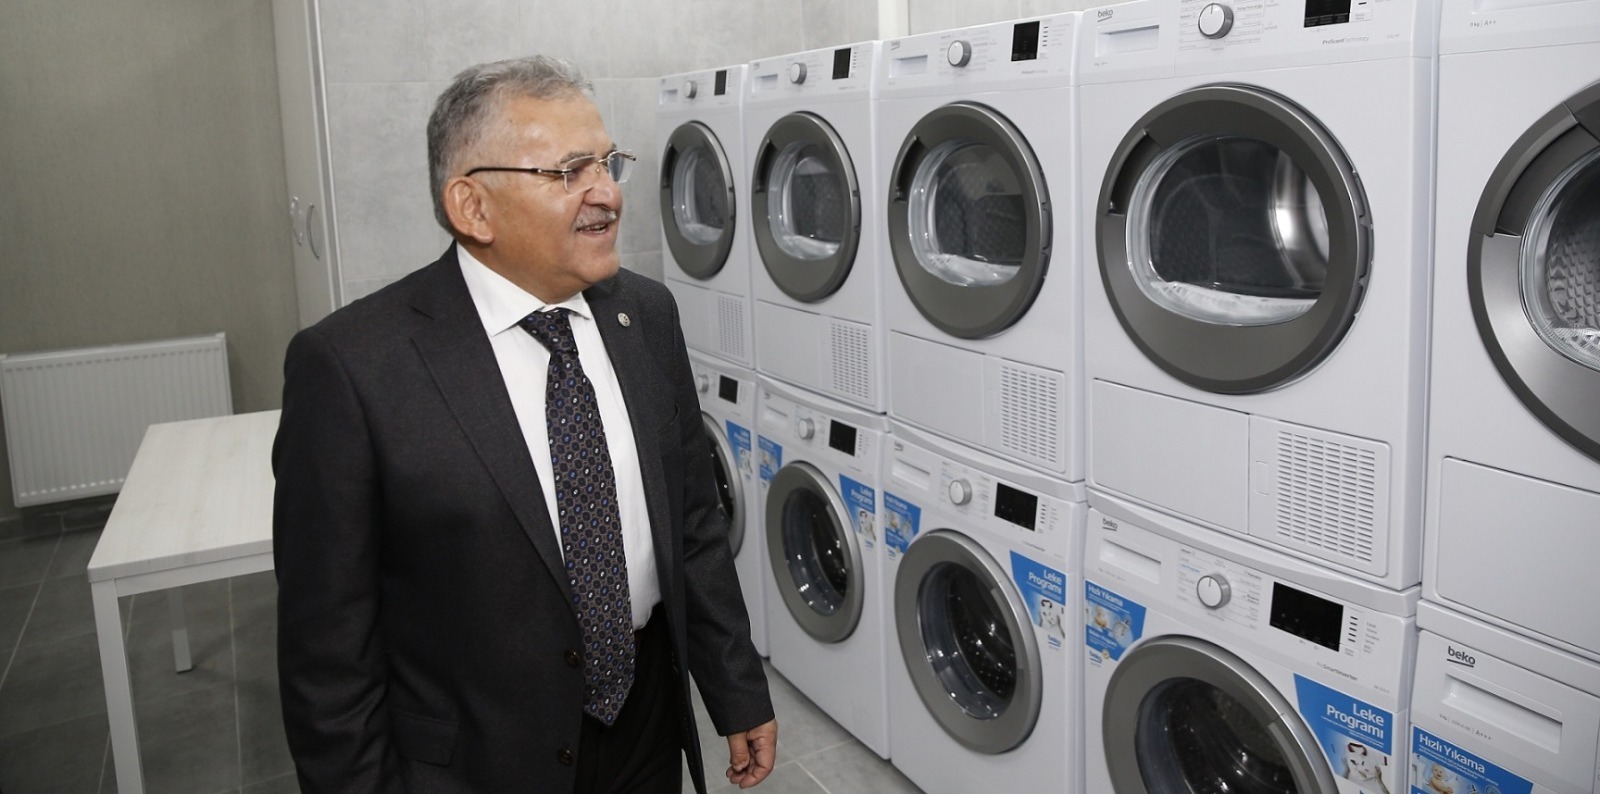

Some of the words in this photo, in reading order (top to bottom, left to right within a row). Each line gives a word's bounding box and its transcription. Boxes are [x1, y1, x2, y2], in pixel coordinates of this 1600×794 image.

[1097, 9, 1114, 22] beko
[1043, 569, 1062, 585] Leke
[1446, 645, 1476, 667] beko
[1326, 704, 1384, 739] Programı
[1353, 703, 1384, 726] Leke
[1419, 733, 1443, 753] Hızlı
[1443, 744, 1486, 774] Yıkama
